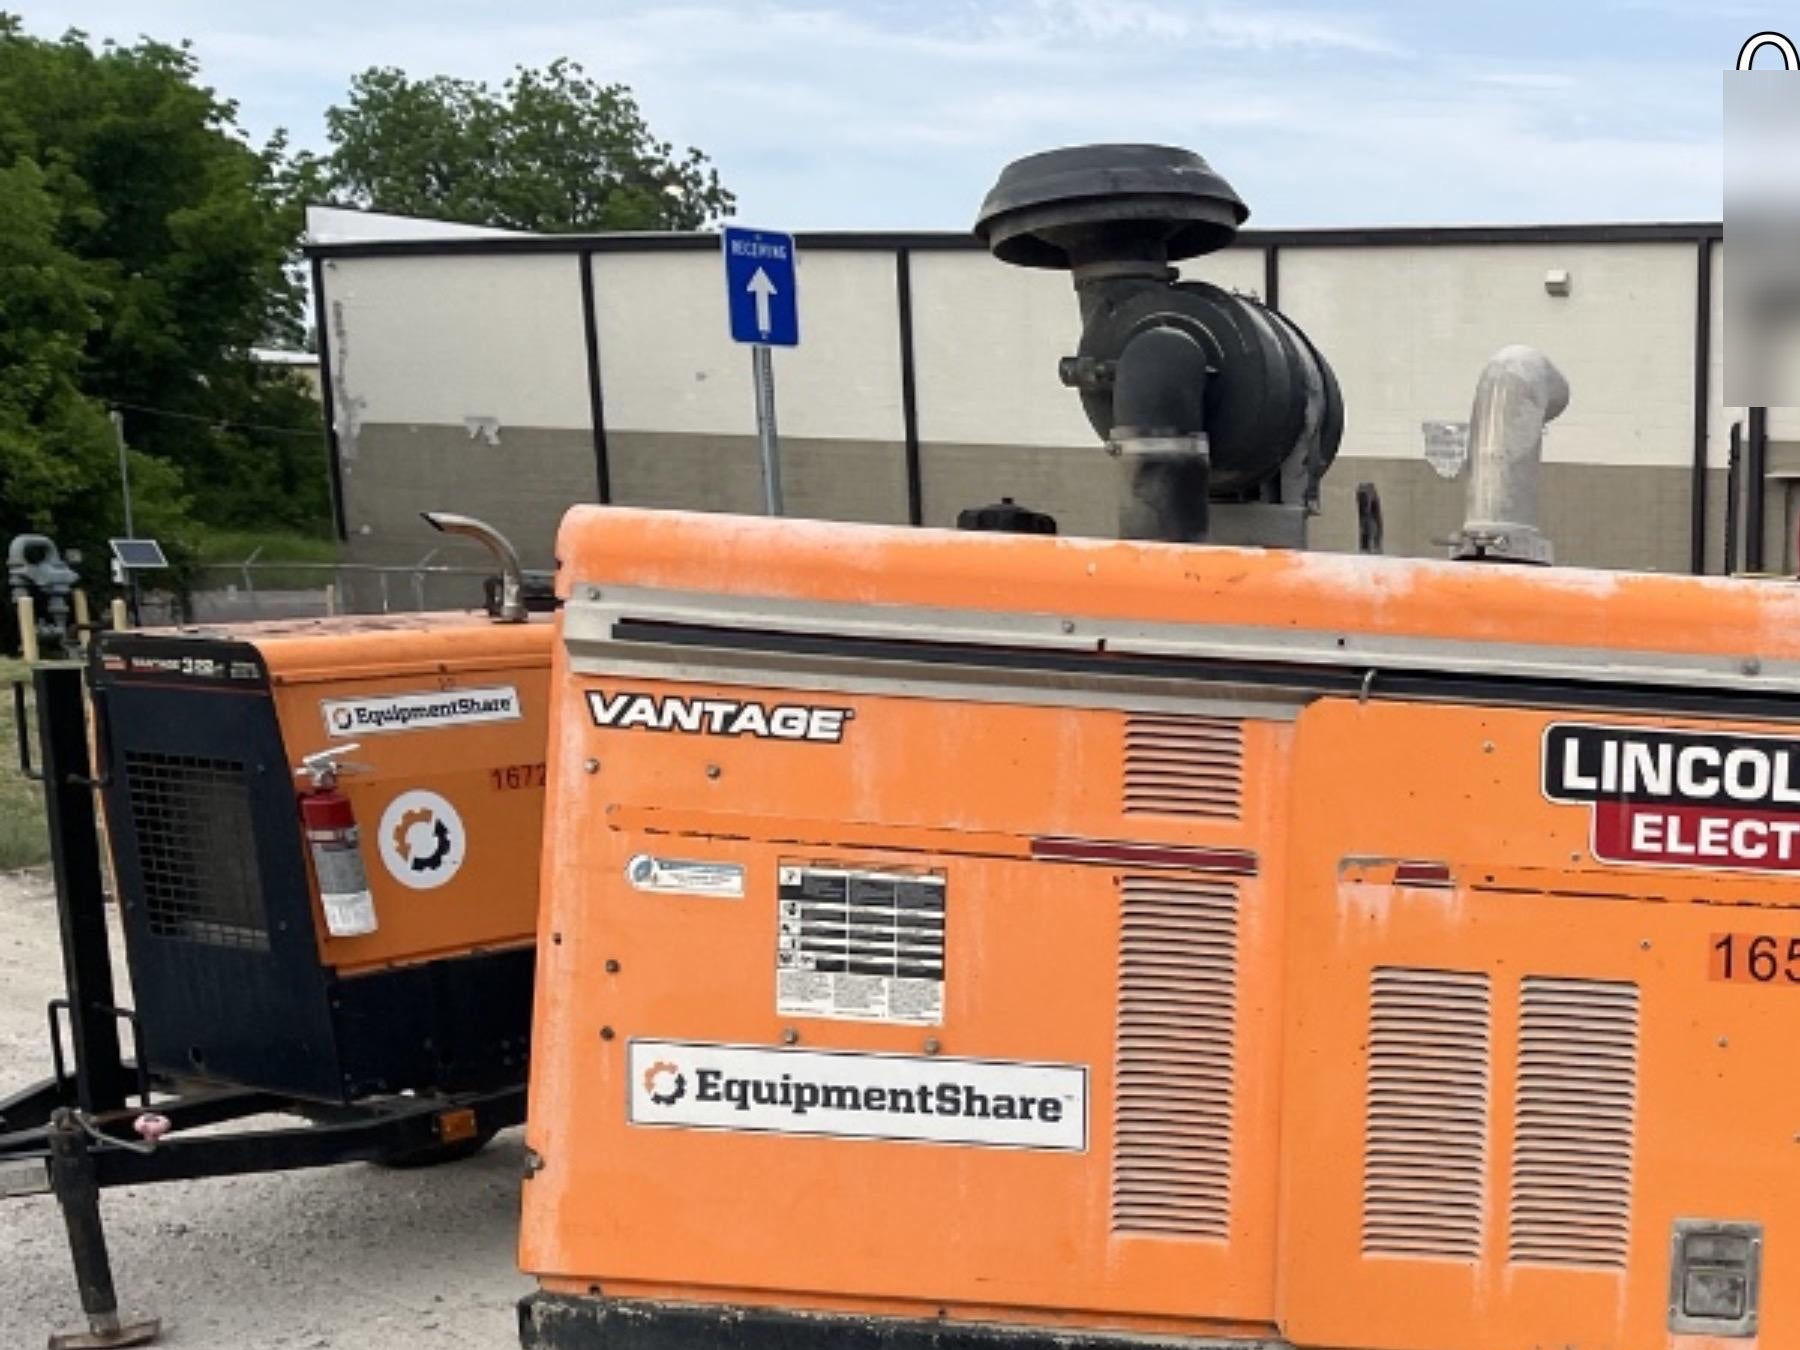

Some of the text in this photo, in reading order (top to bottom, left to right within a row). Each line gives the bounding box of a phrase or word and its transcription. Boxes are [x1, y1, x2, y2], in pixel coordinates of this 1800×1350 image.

[354, 697, 512, 727] EquipmentShare
[586, 690, 846, 741] VANTAGE
[695, 1069, 1063, 1123] EquipmentShare
